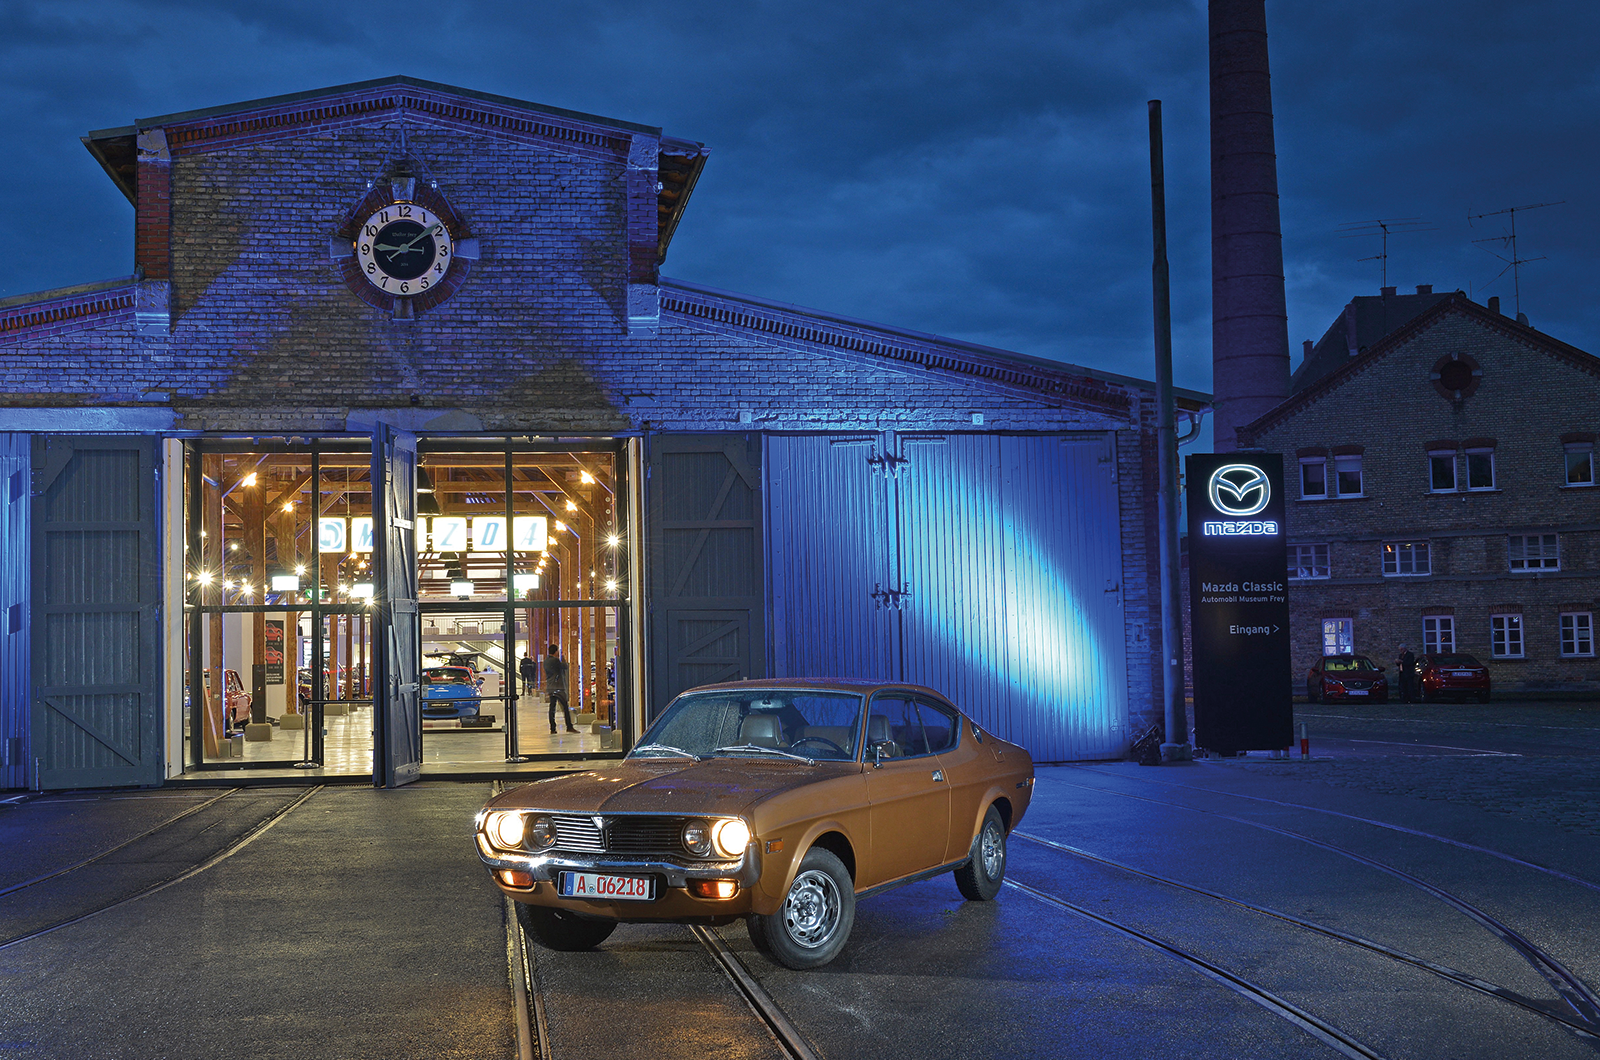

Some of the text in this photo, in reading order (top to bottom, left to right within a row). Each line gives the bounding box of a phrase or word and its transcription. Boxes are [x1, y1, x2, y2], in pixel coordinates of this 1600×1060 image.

[380, 211, 389, 223] 11
[397, 205, 412, 217] 12
[421, 212, 427, 223] 1
[365, 225, 378, 237] 10
[434, 226, 443, 237] 2
[361, 243, 370, 255] 9
[439, 245, 448, 257] 3
[367, 262, 376, 274] 8
[434, 262, 443, 274] 4
[380, 276, 389, 288] 7
[400, 282, 409, 294] 6
[420, 277, 429, 289] 5
[357, 522, 537, 546] MZDA
[1202, 581, 1283, 592] Mazda Classic
[1269, 595, 1285, 603] Frey
[1229, 625, 1270, 635] Eingang
[576, 876, 645, 896] A 06218
